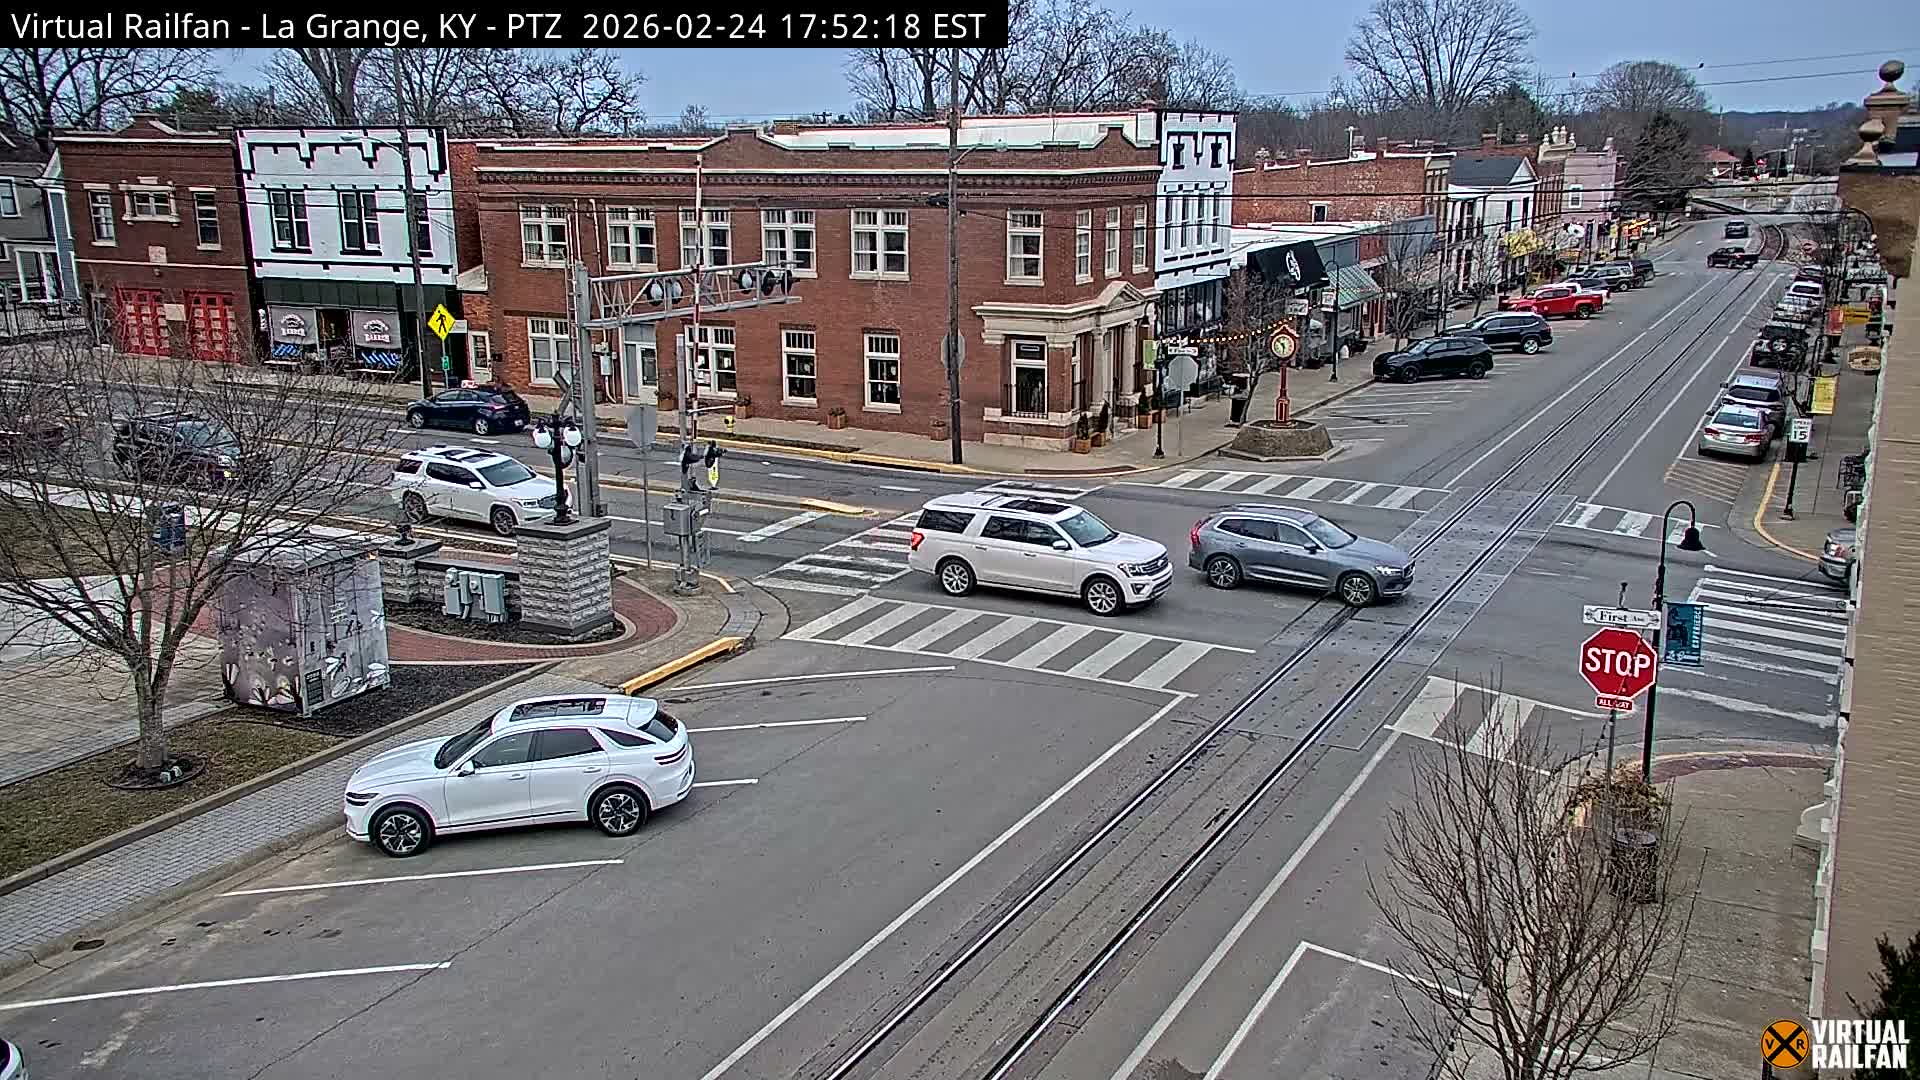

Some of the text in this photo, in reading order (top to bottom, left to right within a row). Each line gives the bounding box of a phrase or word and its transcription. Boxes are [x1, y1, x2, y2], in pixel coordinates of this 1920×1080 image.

[1793, 430, 1807, 440] 15
[1600, 610, 1628, 622] First
[1585, 647, 1651, 678] STOP
[1599, 698, 1612, 706] ALL
